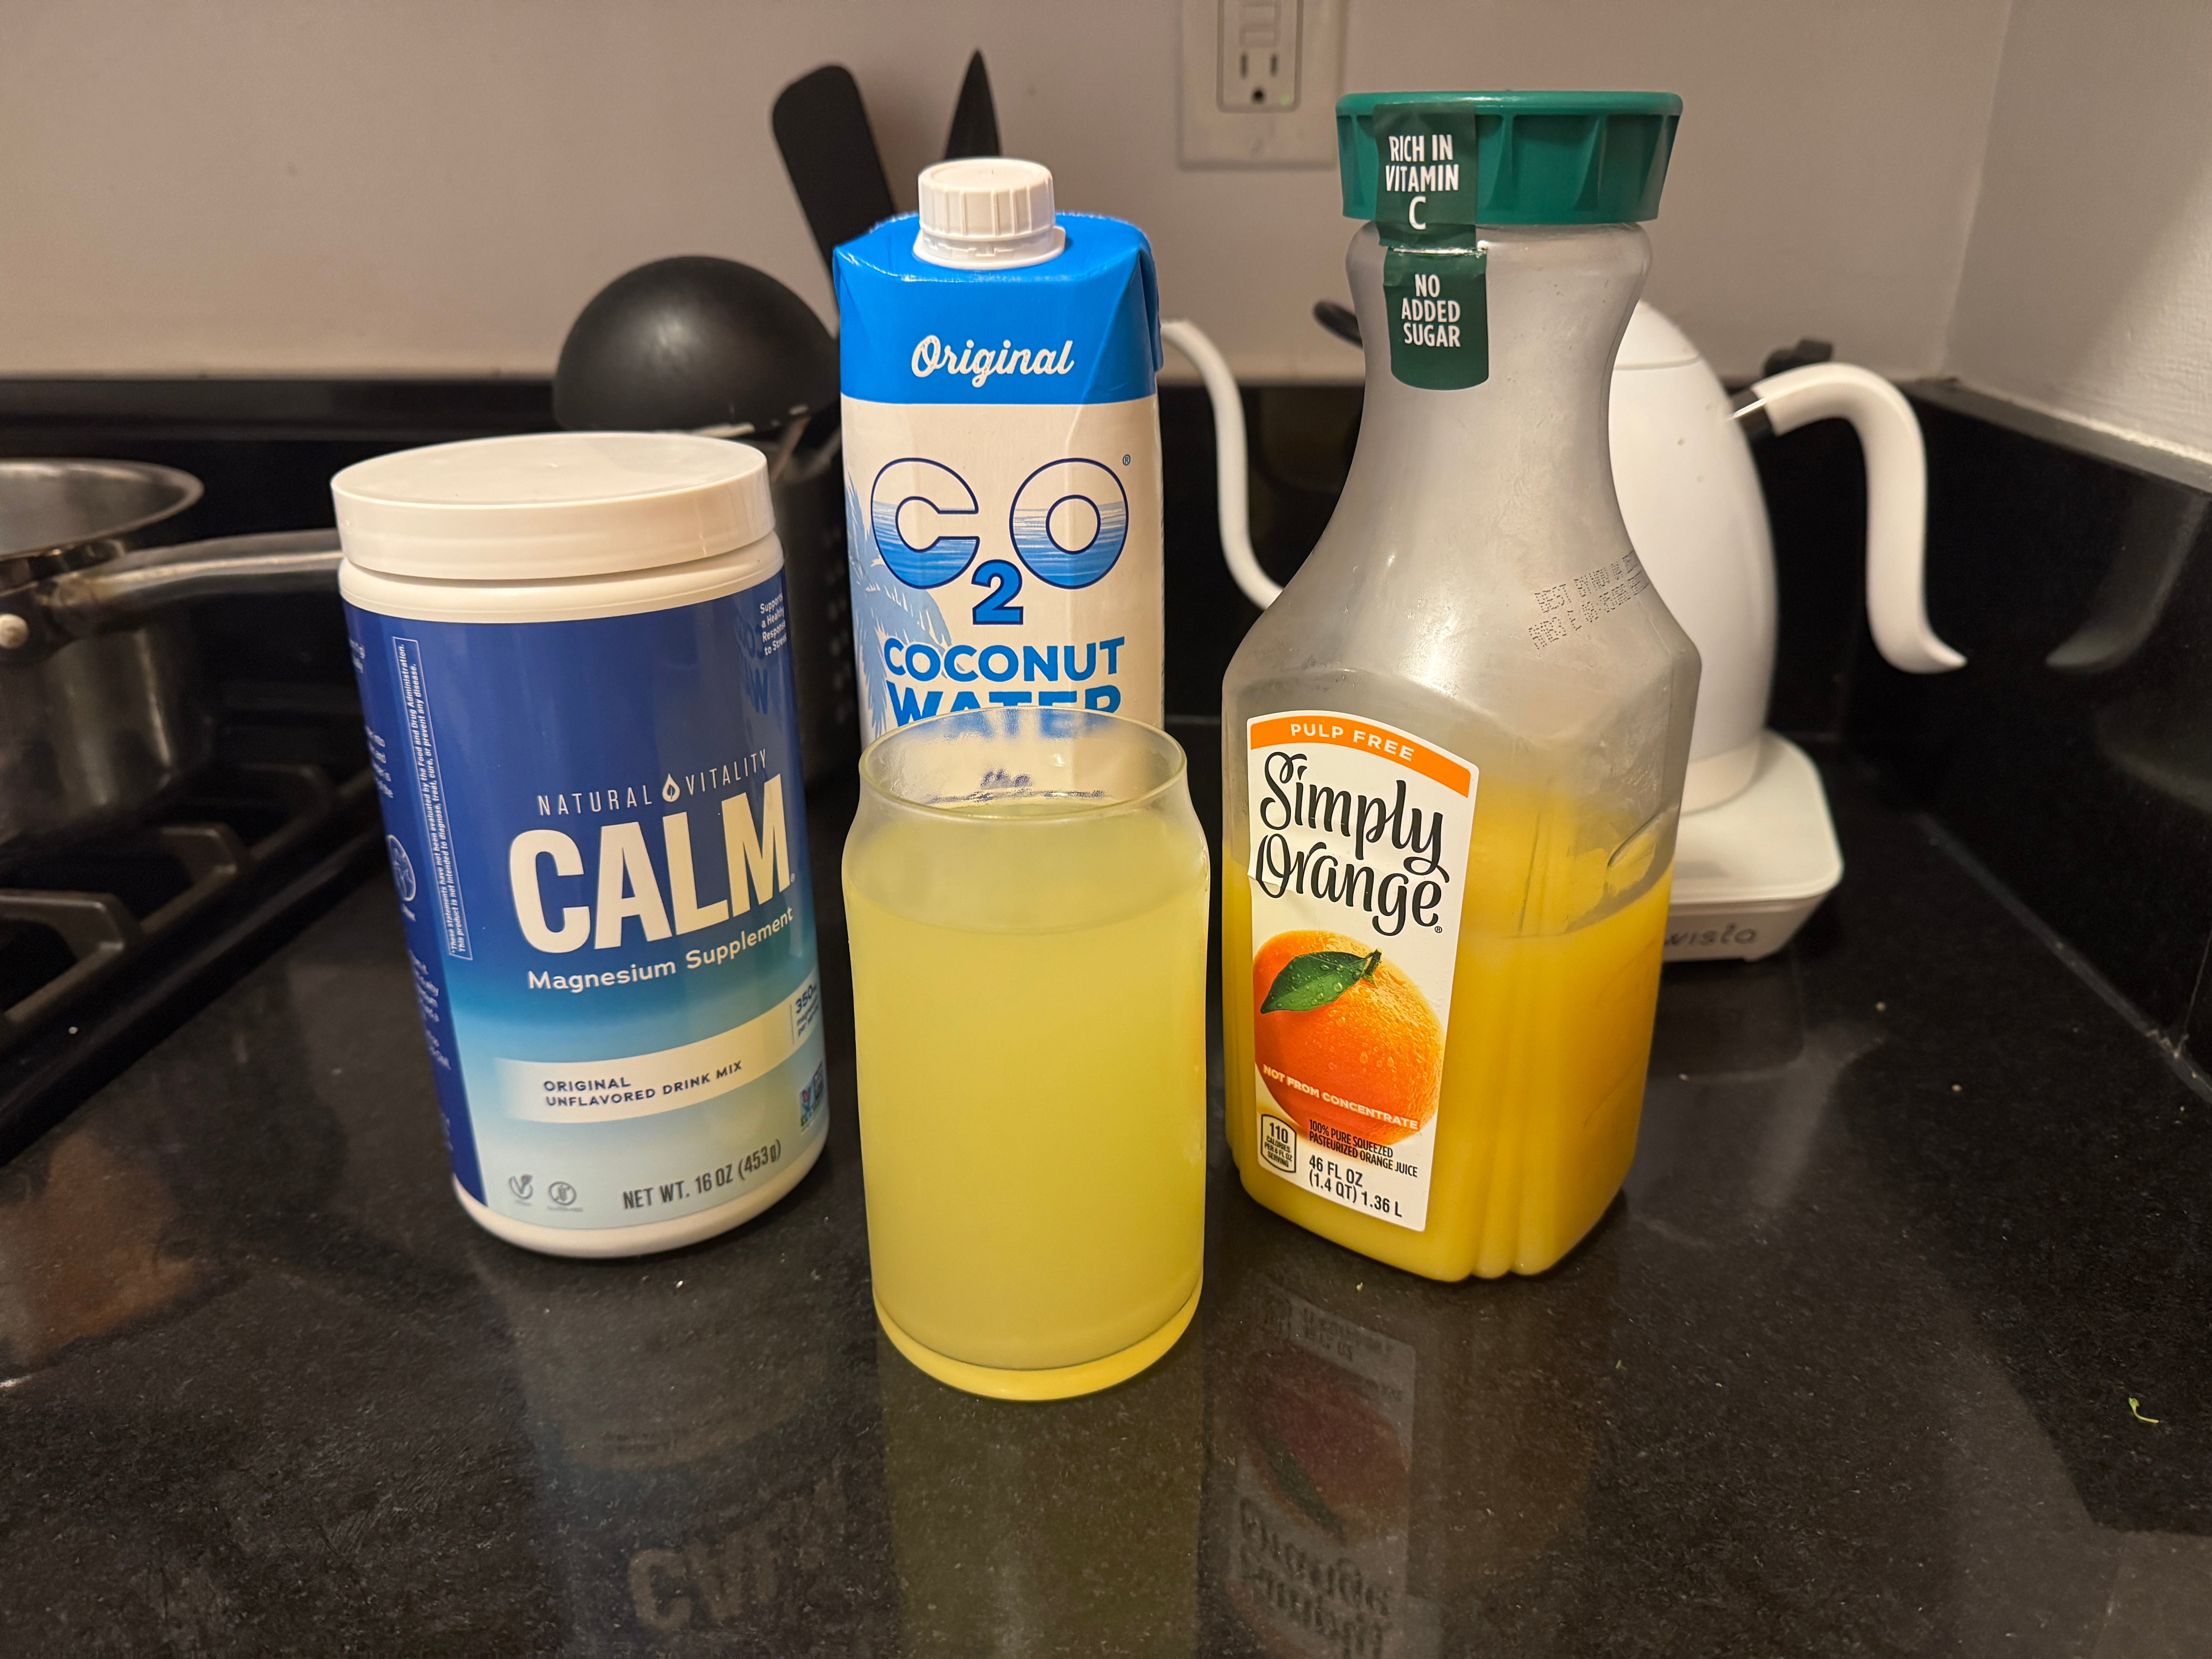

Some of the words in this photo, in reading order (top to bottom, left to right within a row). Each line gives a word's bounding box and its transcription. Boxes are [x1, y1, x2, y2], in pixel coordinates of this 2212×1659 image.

[1389, 134, 1425, 163] RICH
[1432, 134, 1453, 161] IN
[1385, 164, 1459, 192] VITAMIN
[1408, 196, 1426, 230] C
[1415, 273, 1440, 298] NO
[1401, 298, 1460, 323] ADDED
[1403, 323, 1460, 347] SUGAR
[912, 335, 1074, 388] Original
[764, 646, 772, 655] to
[884, 636, 1125, 682] COCONUT
[398, 644, 414, 708] Administration.
[411, 664, 421, 697] disease.
[409, 709, 418, 728] Drug
[419, 716, 431, 747] prevent
[412, 730, 421, 745] and
[426, 748, 431, 756] or
[1291, 723, 1343, 738] PULP
[1353, 730, 1414, 762] FREE
[416, 747, 424, 766] Food
[424, 783, 430, 792] by
[537, 784, 653, 816] NATURAL
[686, 749, 767, 796] VITALITY
[424, 794, 436, 831] evaluated
[434, 804, 446, 839] diagnose,
[1260, 752, 1449, 883] Simply
[432, 833, 440, 851] been
[441, 851, 453, 884] intended
[510, 774, 790, 953] CALM
[443, 887, 453, 927] statements
[455, 907, 464, 936] product
[529, 957, 676, 993] Magnesium
[686, 906, 794, 969] Supplement
[795, 982, 817, 1014] 350
[544, 1077, 631, 1092] ORIGINAL
[546, 1088, 656, 1107] UNFLAVORED
[663, 1073, 710, 1096] DRINK
[716, 1061, 742, 1079] MIX
[1263, 1064, 1285, 1083] NOT
[1286, 1075, 1319, 1098] FROM
[1322, 1091, 1419, 1130] CONCENTRATE
[1267, 1135, 1290, 1153] CALORIES
[1270, 1122, 1288, 1143] 110
[1310, 1119, 1329, 1137] 100%
[1331, 1128, 1351, 1145] PURE
[1352, 1136, 1393, 1158] SQUEEZED
[1264, 1142, 1274, 1152] PER
[1279, 1150, 1285, 1158] FL
[1285, 1153, 1292, 1162] OZ
[1267, 1151, 1288, 1168] SERVING
[1309, 1131, 1358, 1158] PASTEURIZED
[1360, 1150, 1393, 1170] ORANGE
[1395, 1162, 1418, 1178] JUICE
[623, 1188, 653, 1210] NET
[659, 1182, 689, 1203] WT.
[696, 1174, 712, 1194] 16
[716, 1164, 733, 1187] OZ
[737, 1139, 781, 1181] (453g)
[1309, 1154, 1323, 1172] 46
[1328, 1162, 1341, 1180] FL
[1346, 1168, 1363, 1187] OZ
[1309, 1169, 1331, 1192] (1.4
[1335, 1182, 1357, 1204] QT)
[1361, 1191, 1390, 1213] 1.36
[1395, 1202, 1402, 1217] L
